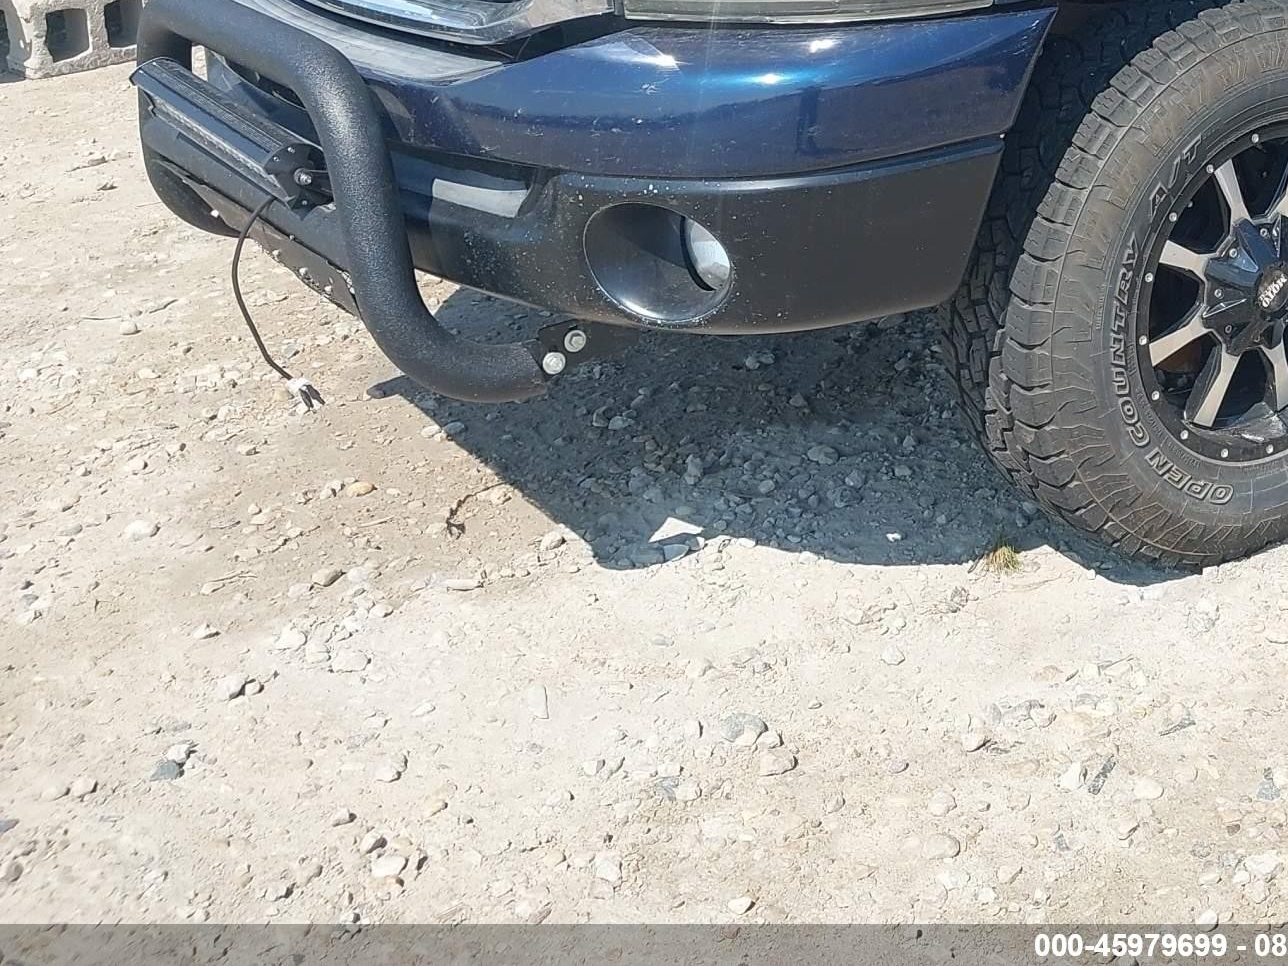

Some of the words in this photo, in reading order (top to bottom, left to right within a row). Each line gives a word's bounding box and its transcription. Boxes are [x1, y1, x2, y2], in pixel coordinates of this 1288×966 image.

[1262, 273, 1288, 308] MOTO
[1110, 233, 1151, 447] COUNTRY
[1144, 446, 1234, 504] OPEN
